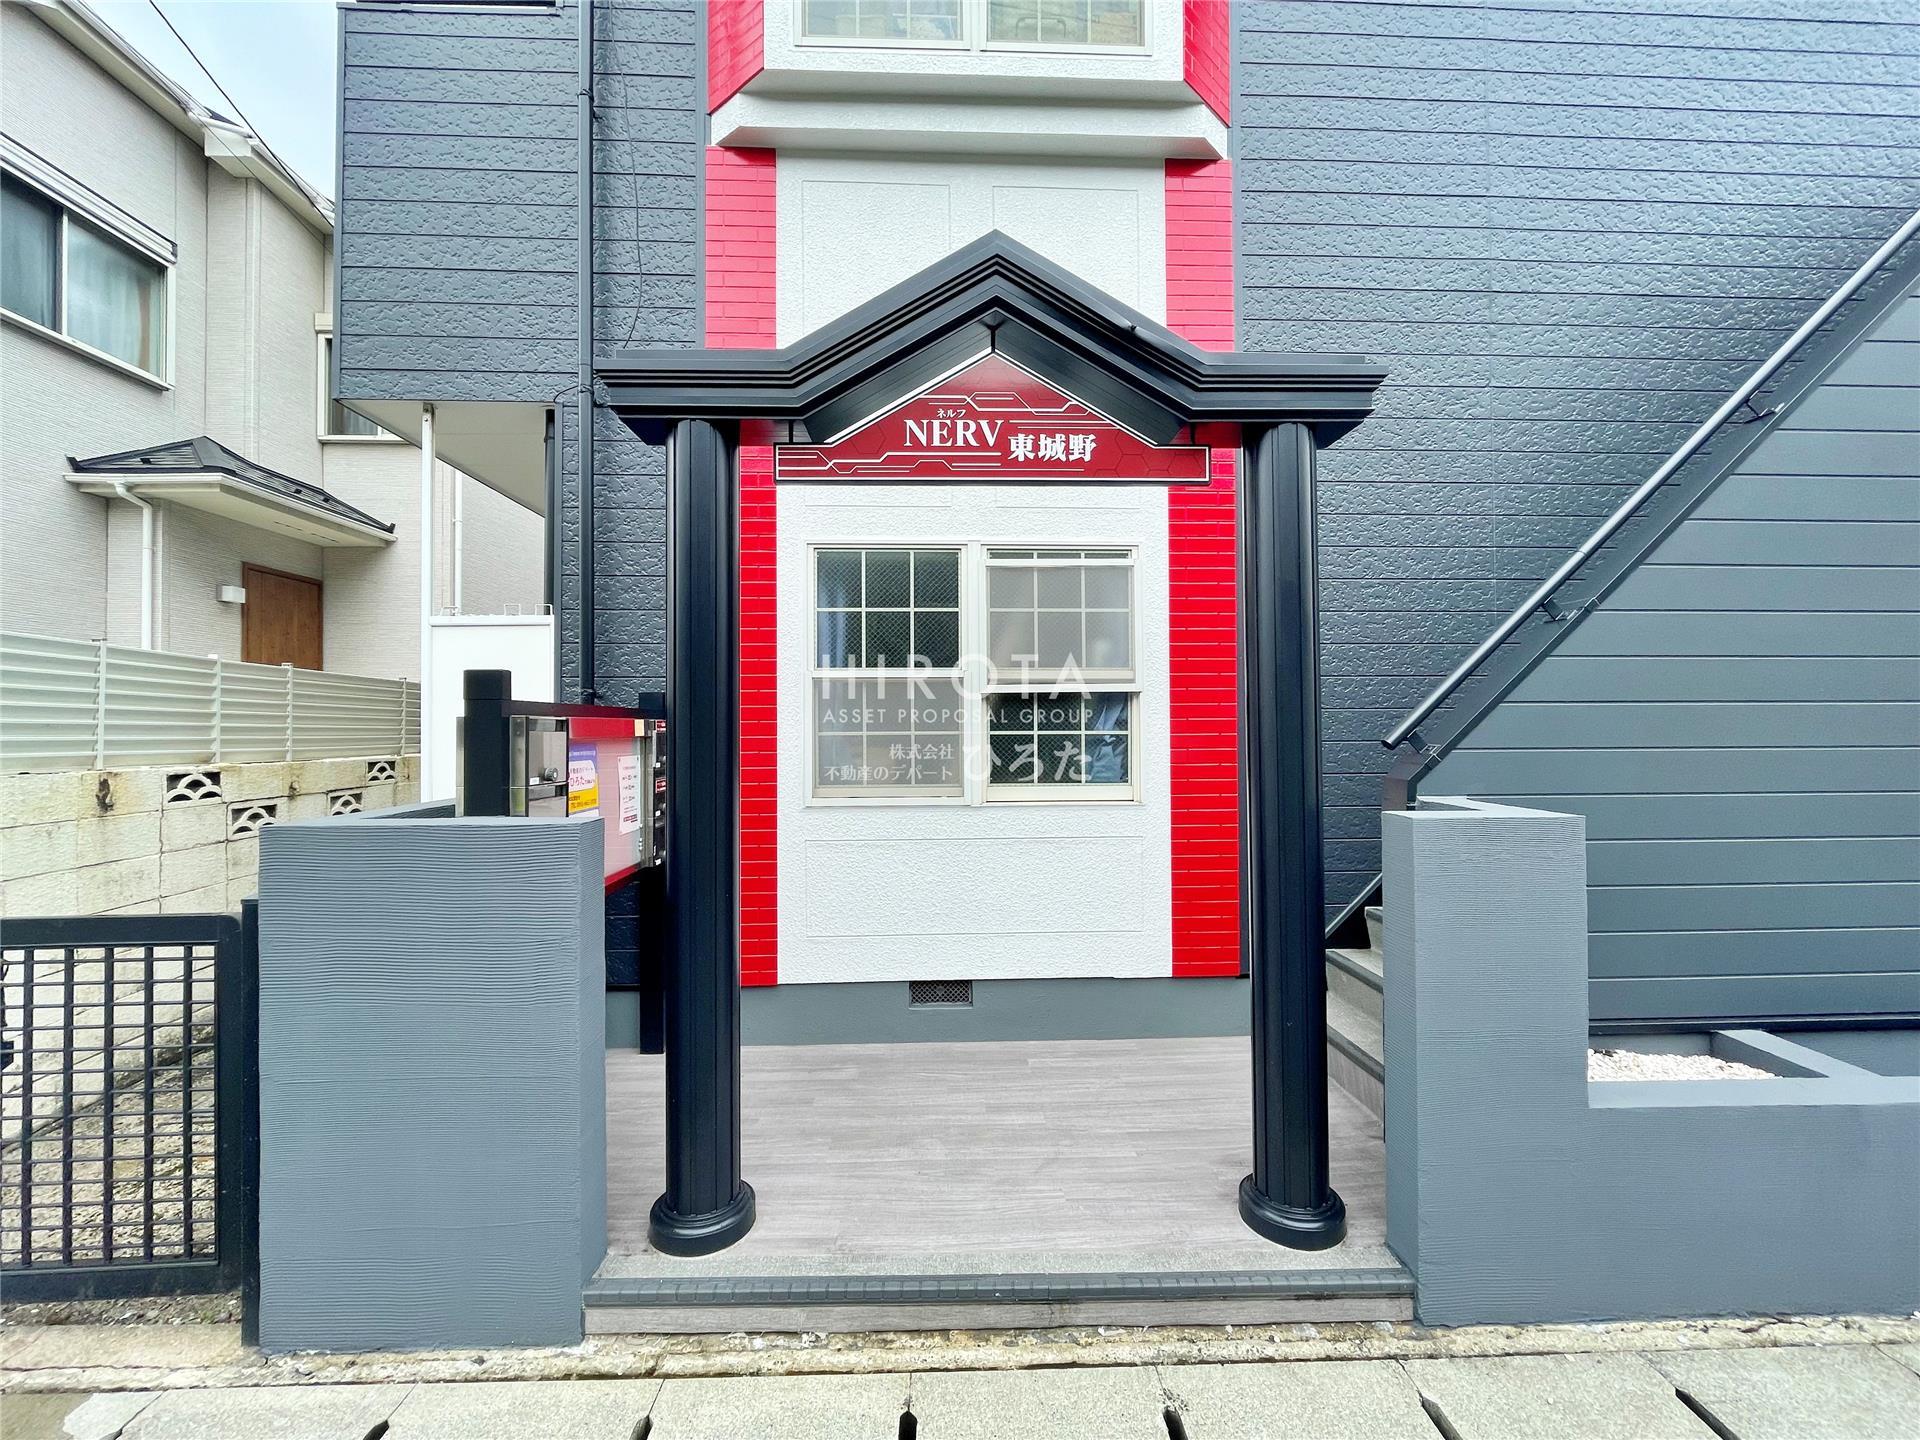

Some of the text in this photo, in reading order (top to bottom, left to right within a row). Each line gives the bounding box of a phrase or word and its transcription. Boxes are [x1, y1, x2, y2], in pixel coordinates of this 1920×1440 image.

[936, 408, 967, 418] ネルフ
[903, 419, 1005, 447] NERV
[1007, 433, 1097, 462] 東城野
